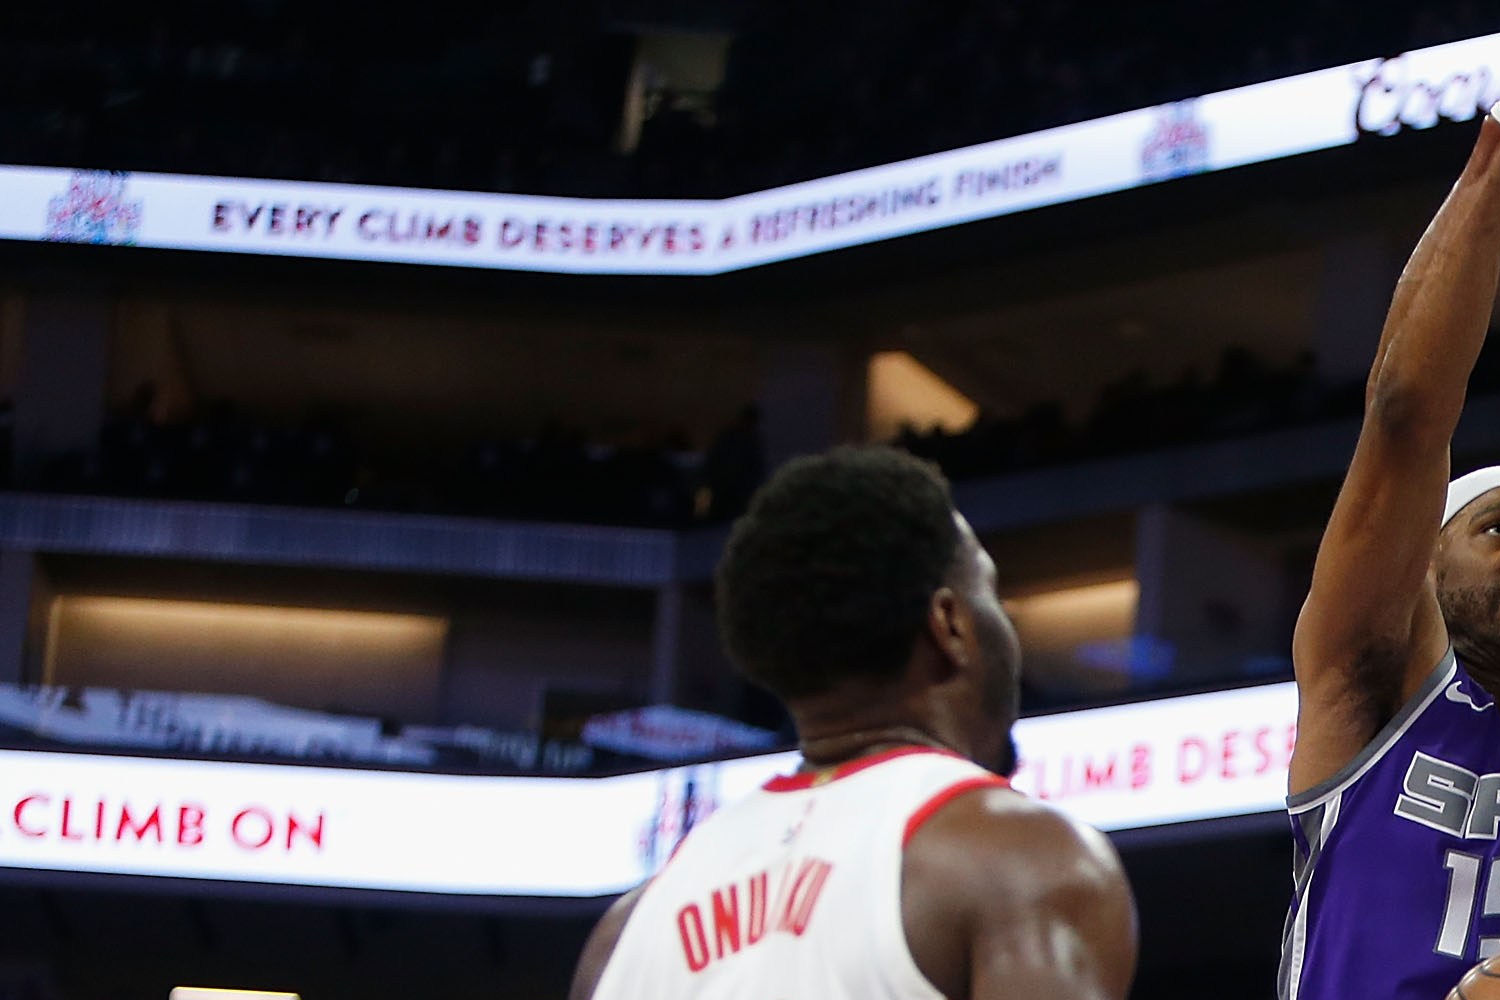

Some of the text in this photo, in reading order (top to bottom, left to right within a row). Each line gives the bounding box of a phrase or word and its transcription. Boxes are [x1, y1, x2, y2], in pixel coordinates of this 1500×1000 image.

[213, 201, 343, 235] EVERY
[357, 210, 482, 245] CLIMB
[500, 218, 705, 253] DESERVES
[751, 179, 942, 243] REFRESHING
[954, 154, 1065, 196] FINISH
[1018, 745, 1151, 801] LIMB
[13, 793, 325, 851] CLIMB ON
[677, 856, 836, 974] ONUKU
